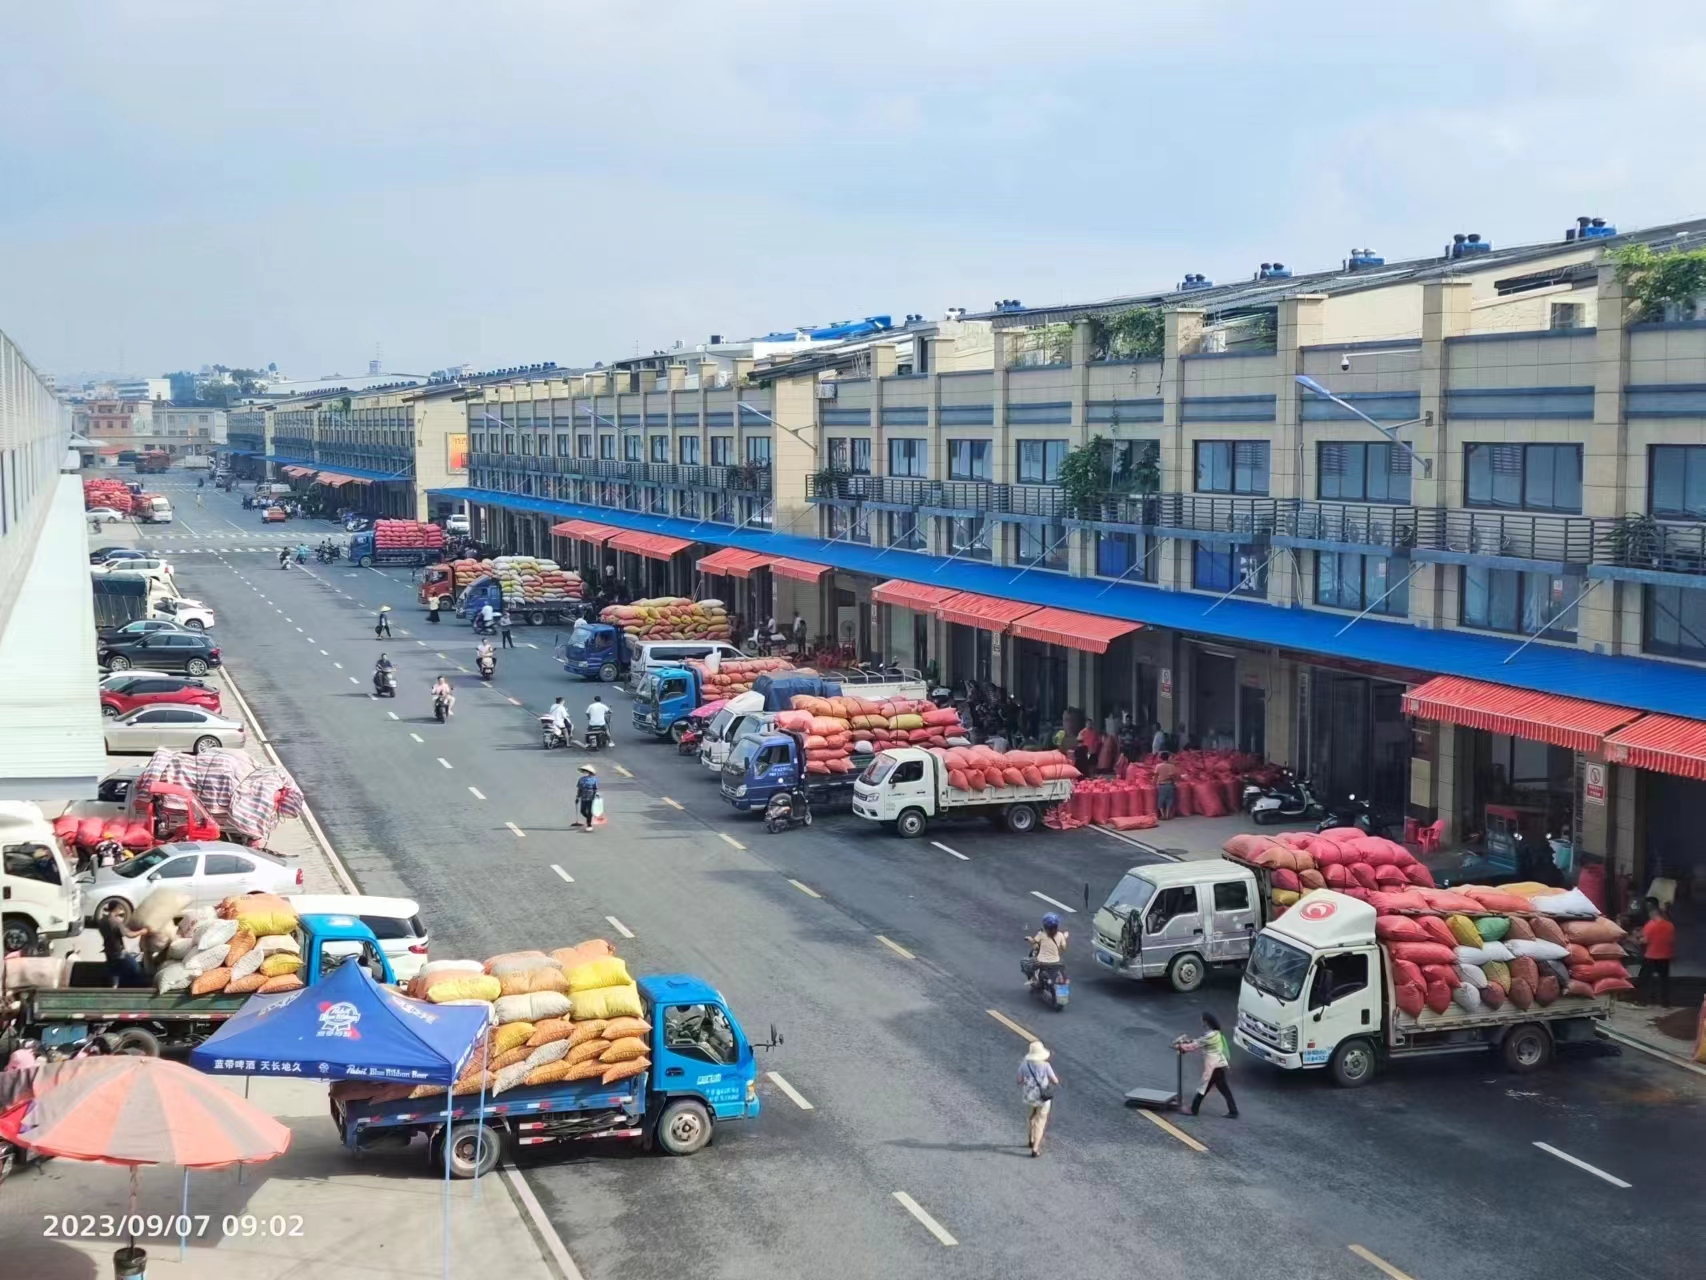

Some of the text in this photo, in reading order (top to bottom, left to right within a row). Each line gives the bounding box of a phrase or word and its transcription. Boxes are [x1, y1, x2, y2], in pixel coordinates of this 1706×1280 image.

[213, 1059, 302, 1072] 蓝带啤酒 天长地久
[385, 1068, 410, 1079] Ribbon
